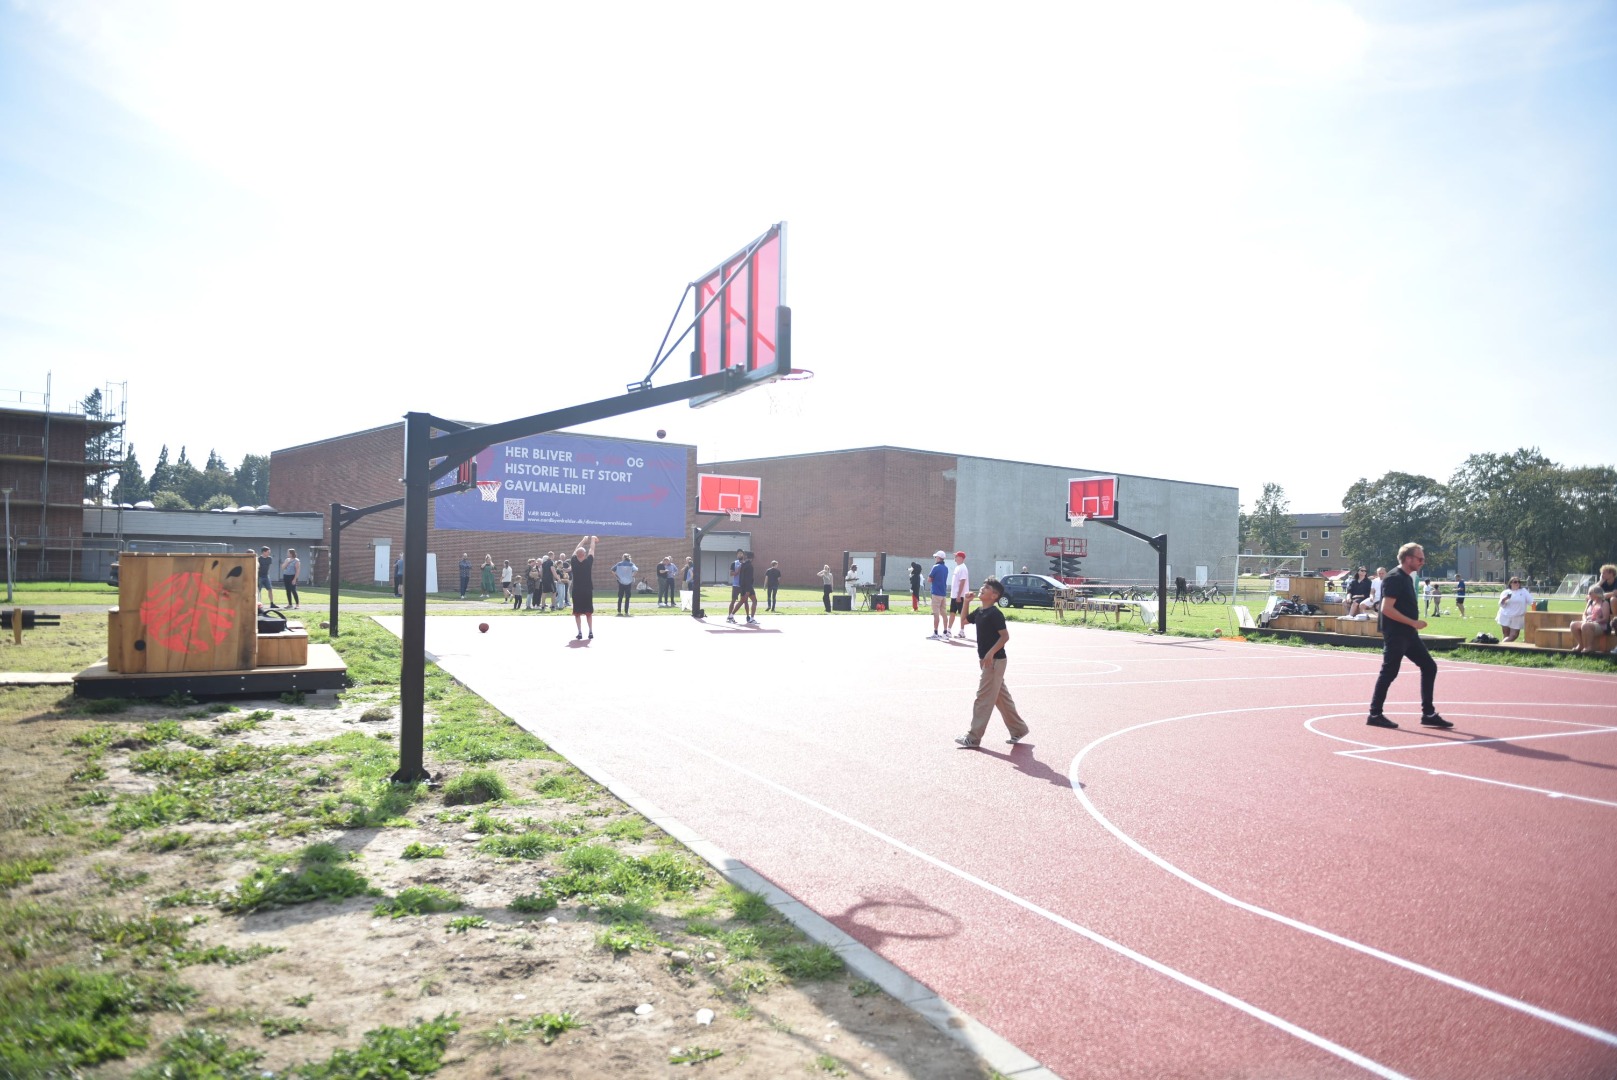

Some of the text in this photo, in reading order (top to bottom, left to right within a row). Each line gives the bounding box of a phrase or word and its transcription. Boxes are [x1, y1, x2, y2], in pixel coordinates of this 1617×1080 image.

[505, 445, 529, 459] HER
[532, 448, 573, 463] BLIVER
[626, 457, 644, 468] OG
[504, 462, 633, 483] HISTORIE TIL ET STORT
[504, 479, 587, 496] GAVLMALERI!
